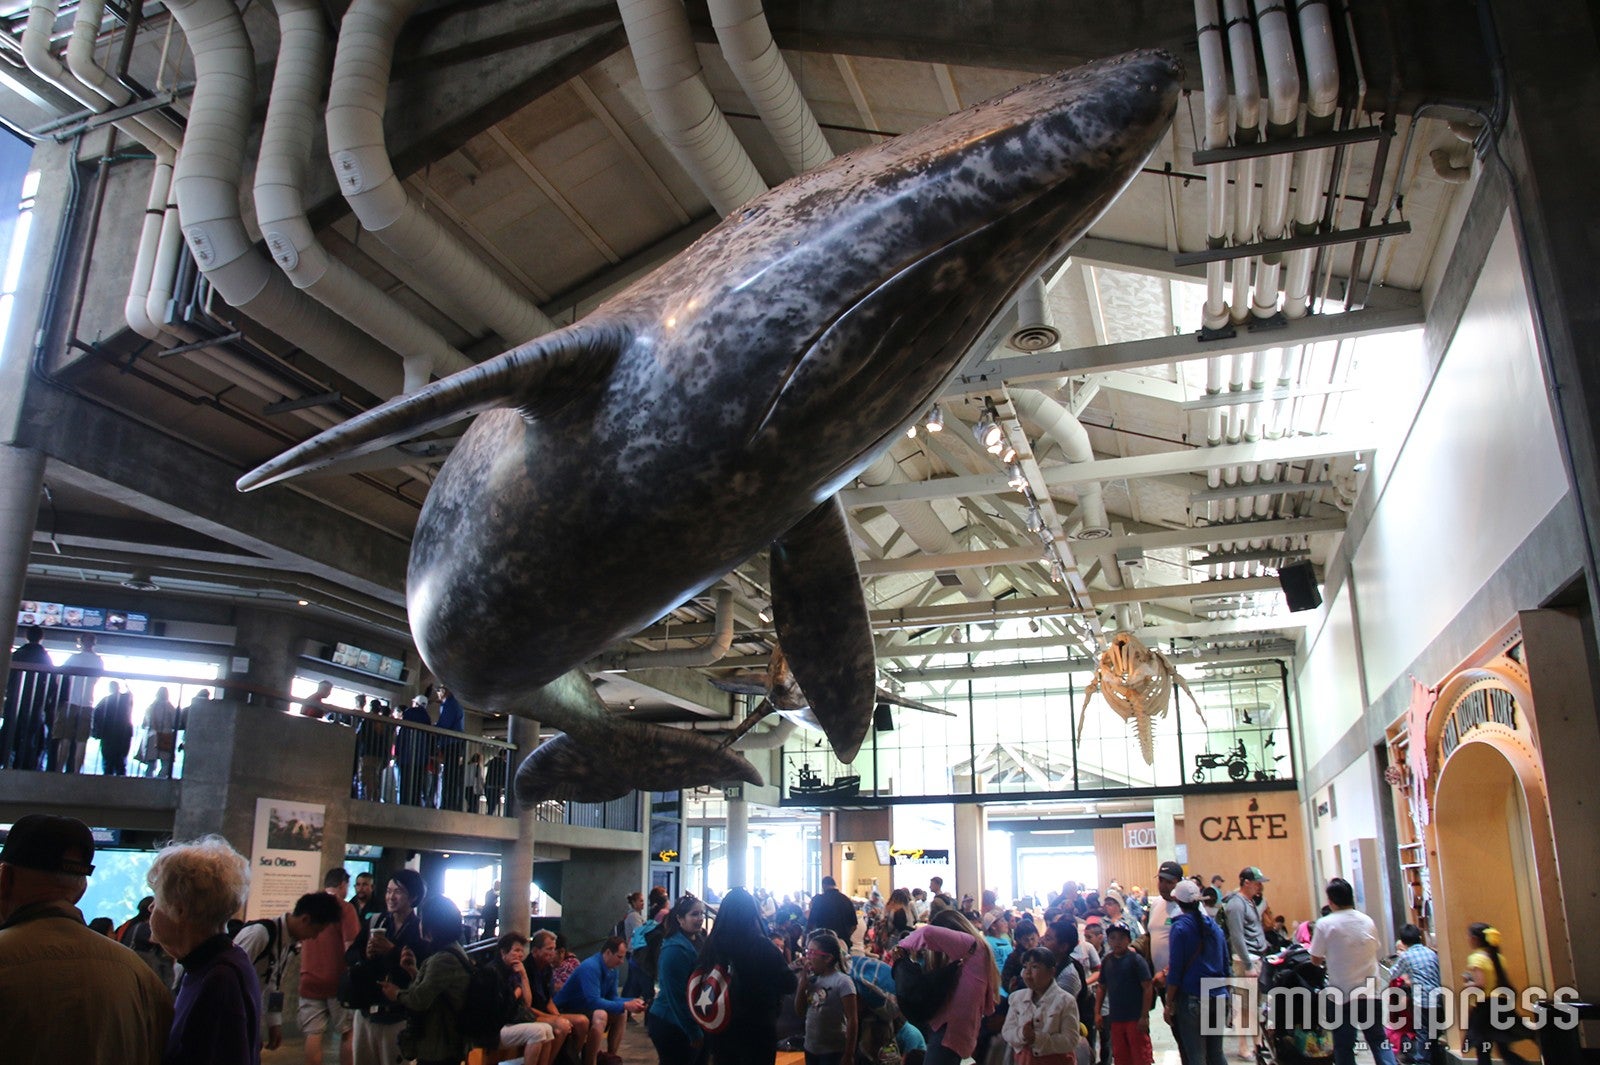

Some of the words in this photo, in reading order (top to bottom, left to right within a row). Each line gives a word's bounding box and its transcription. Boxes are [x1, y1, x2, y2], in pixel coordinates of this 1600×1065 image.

[1199, 813, 1288, 842] CAFE
[259, 856, 273, 866] Sea
[274, 857, 297, 867] Otters
